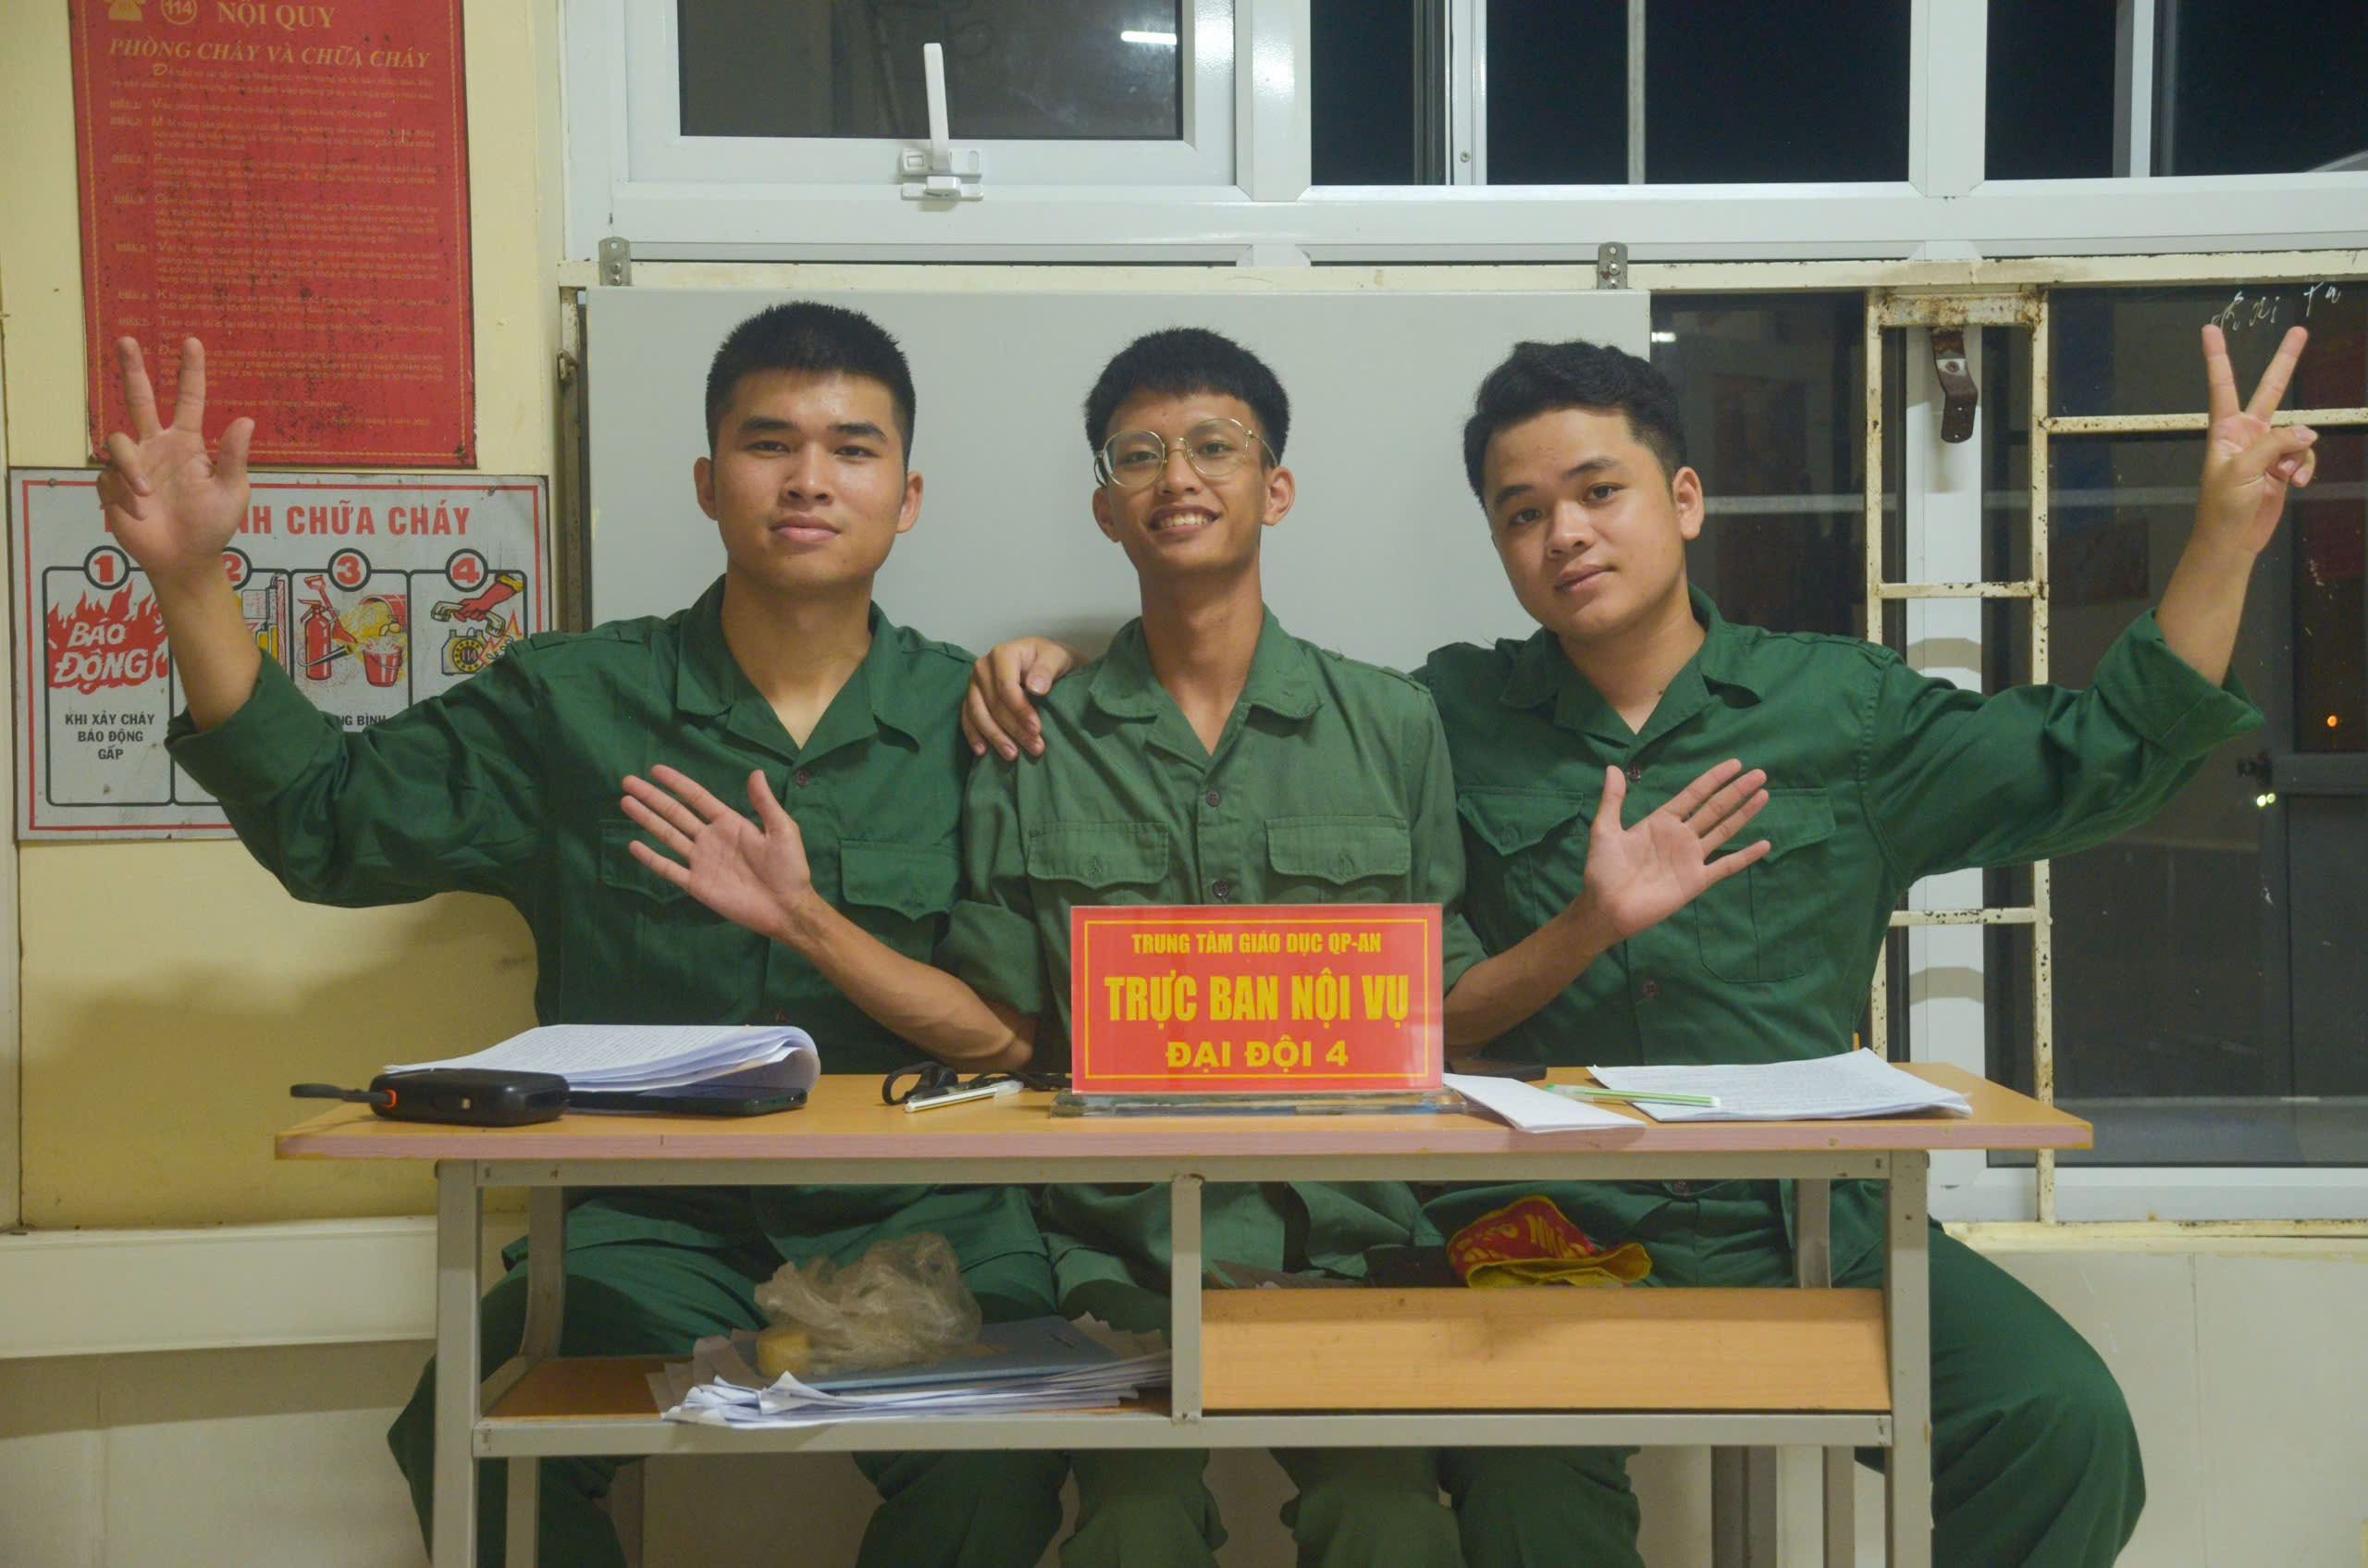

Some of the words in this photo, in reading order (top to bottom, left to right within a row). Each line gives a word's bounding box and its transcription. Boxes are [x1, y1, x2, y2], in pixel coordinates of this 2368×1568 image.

[165, 0, 193, 15] 114
[217, 0, 266, 28] NỘI
[276, 5, 335, 31] QUY
[110, 35, 191, 59] PHÒNG
[197, 41, 260, 61] CHÁY
[265, 43, 294, 64] VÀ
[301, 44, 364, 68] CHỮA
[370, 47, 430, 68] CHÁY
[286, 500, 376, 535] CHỮA
[388, 500, 471, 535] CHÁY
[93, 555, 114, 583] 1
[337, 555, 362, 585] 3
[451, 557, 480, 584] 4
[67, 617, 128, 648] BÁO
[65, 713, 88, 725] KHI
[121, 710, 155, 725] CHÁY
[78, 729, 105, 742] BÁO
[108, 728, 144, 744] ĐỘNG
[98, 744, 124, 759] GẤP
[1131, 933, 1190, 954] TRUNG
[1196, 930, 1234, 954] TÂM
[1239, 930, 1281, 954] GIÁO
[1286, 932, 1323, 957] DỤC
[1327, 932, 1382, 955] QP-AN
[1104, 969, 1197, 1030] TRỰC
[1210, 975, 1279, 1021] BAN
[1291, 967, 1350, 1030] NỘI
[1362, 974, 1410, 1029] VỤ
[1166, 1041, 1232, 1073] ĐẠI
[1244, 1034, 1312, 1073] ĐỘI
[1326, 1040, 1349, 1067] 4
